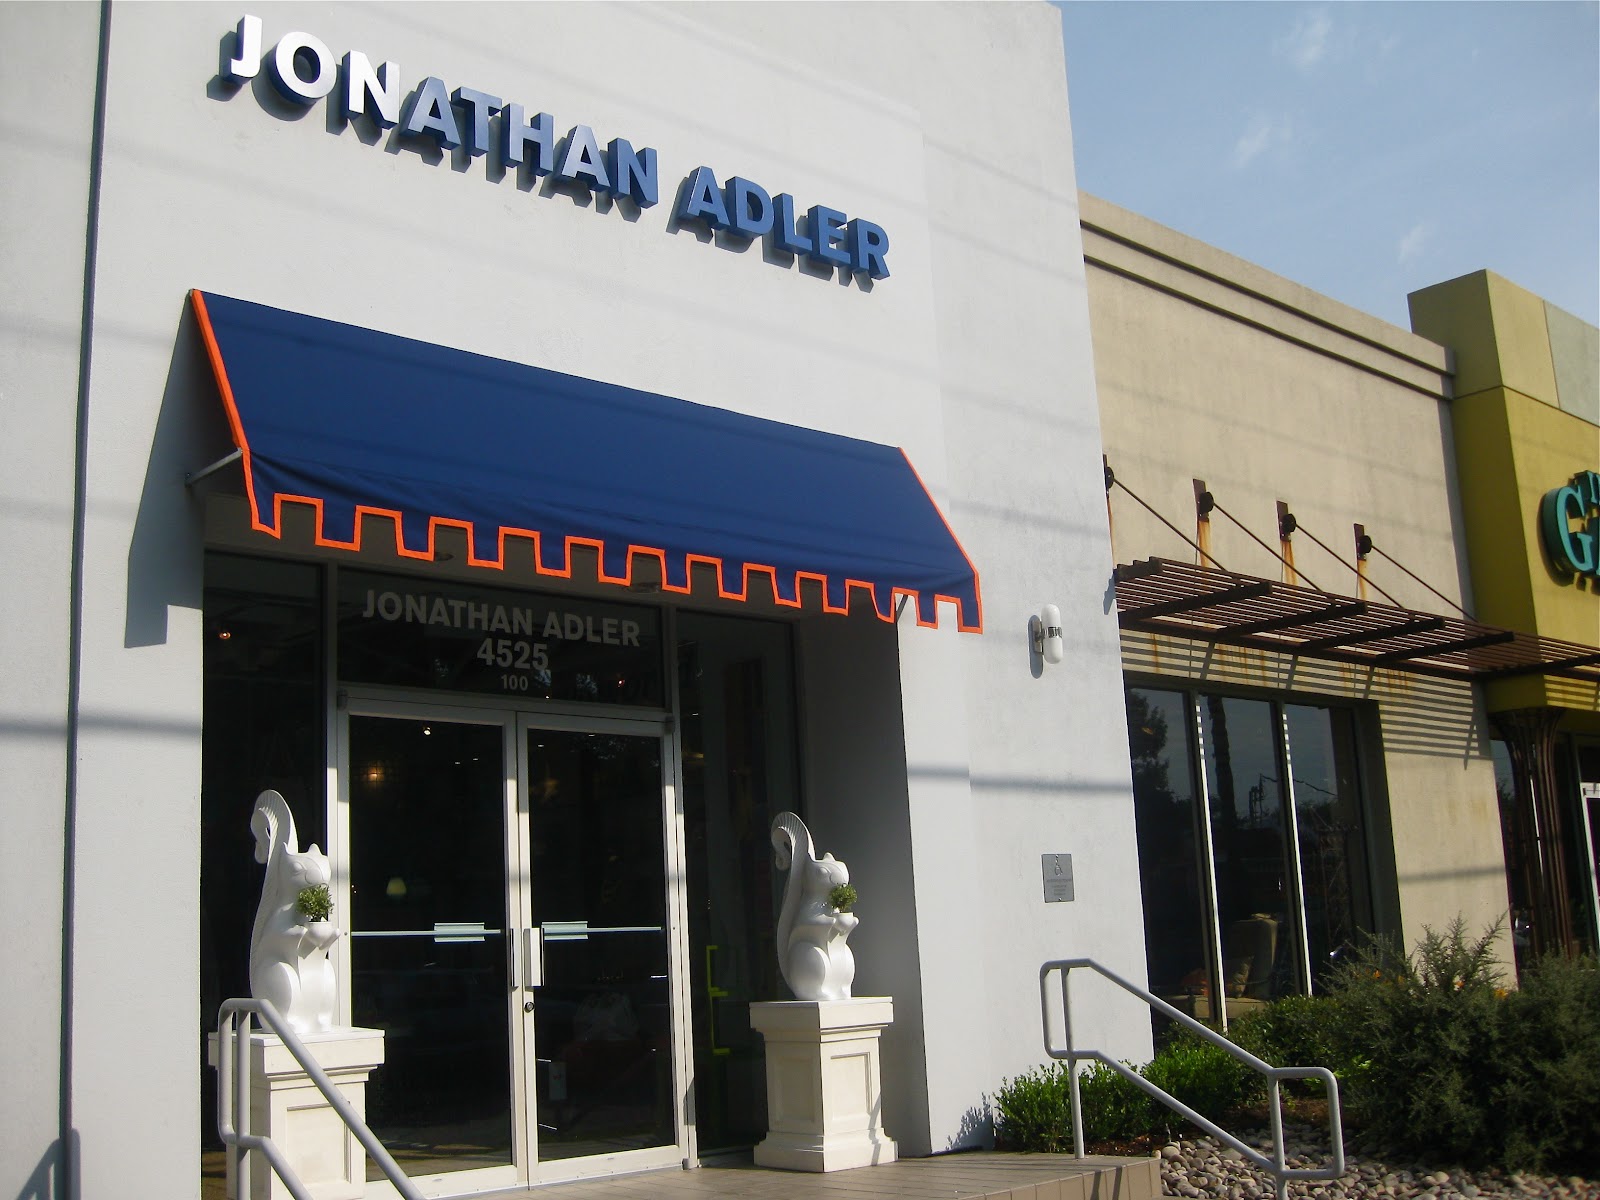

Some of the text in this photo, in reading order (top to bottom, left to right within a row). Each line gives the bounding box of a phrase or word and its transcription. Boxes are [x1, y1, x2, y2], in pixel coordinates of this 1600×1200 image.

[229, 14, 890, 279] JONATHAN ADLER
[362, 589, 640, 647] JONATHAN ADLER
[476, 638, 549, 671] 4525
[501, 674, 529, 692] 100
